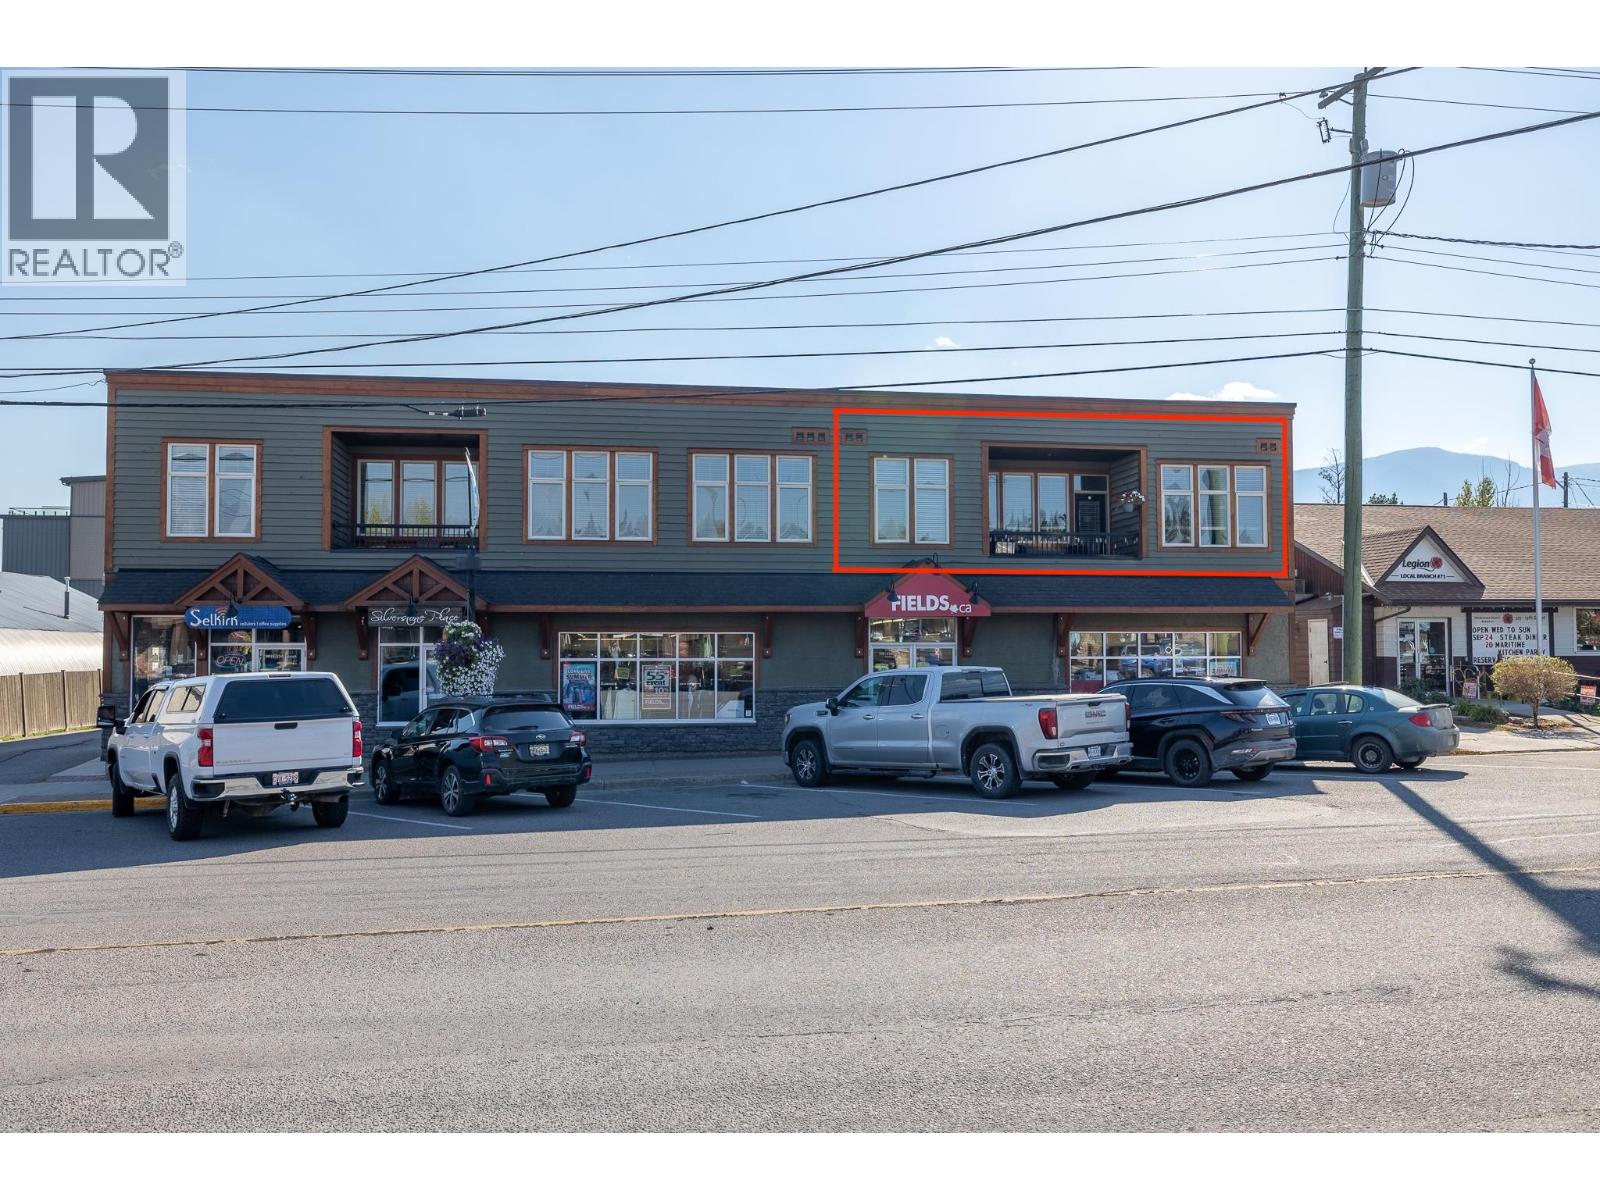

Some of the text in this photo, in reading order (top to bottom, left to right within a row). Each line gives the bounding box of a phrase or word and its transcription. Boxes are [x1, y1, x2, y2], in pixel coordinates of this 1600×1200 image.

[1402, 559, 1430, 569] Legion
[891, 594, 950, 612] FIELDS
[190, 609, 238, 627] Selkirk
[424, 607, 460, 624] Place
[216, 656, 244, 666] OPEN
